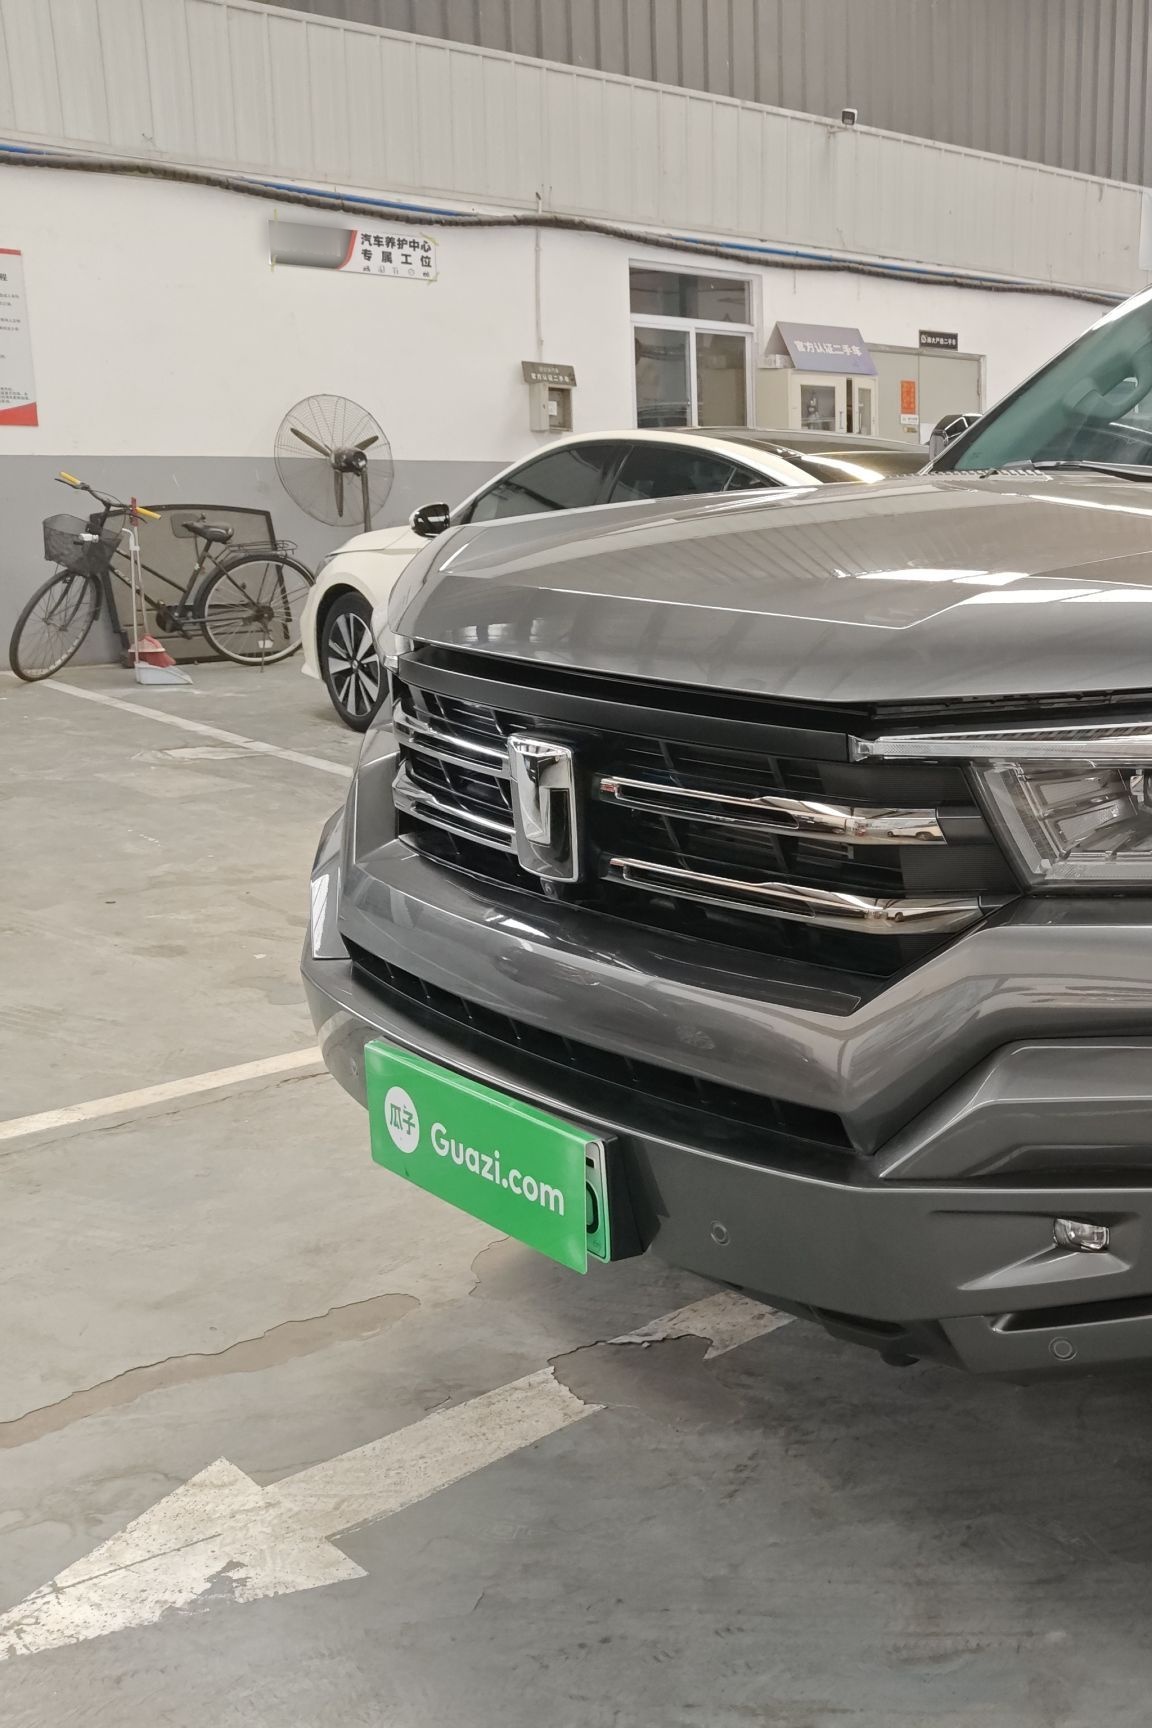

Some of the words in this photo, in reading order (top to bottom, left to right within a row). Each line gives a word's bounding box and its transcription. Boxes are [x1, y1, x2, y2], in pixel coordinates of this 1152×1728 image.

[361, 233, 431, 252] 汽车养护中心
[361, 249, 432, 268] 专属工位
[794, 340, 862, 356] 官方认证二手车
[390, 1103, 416, 1135] 瓜子
[430, 1122, 565, 1216] Guazi.com
